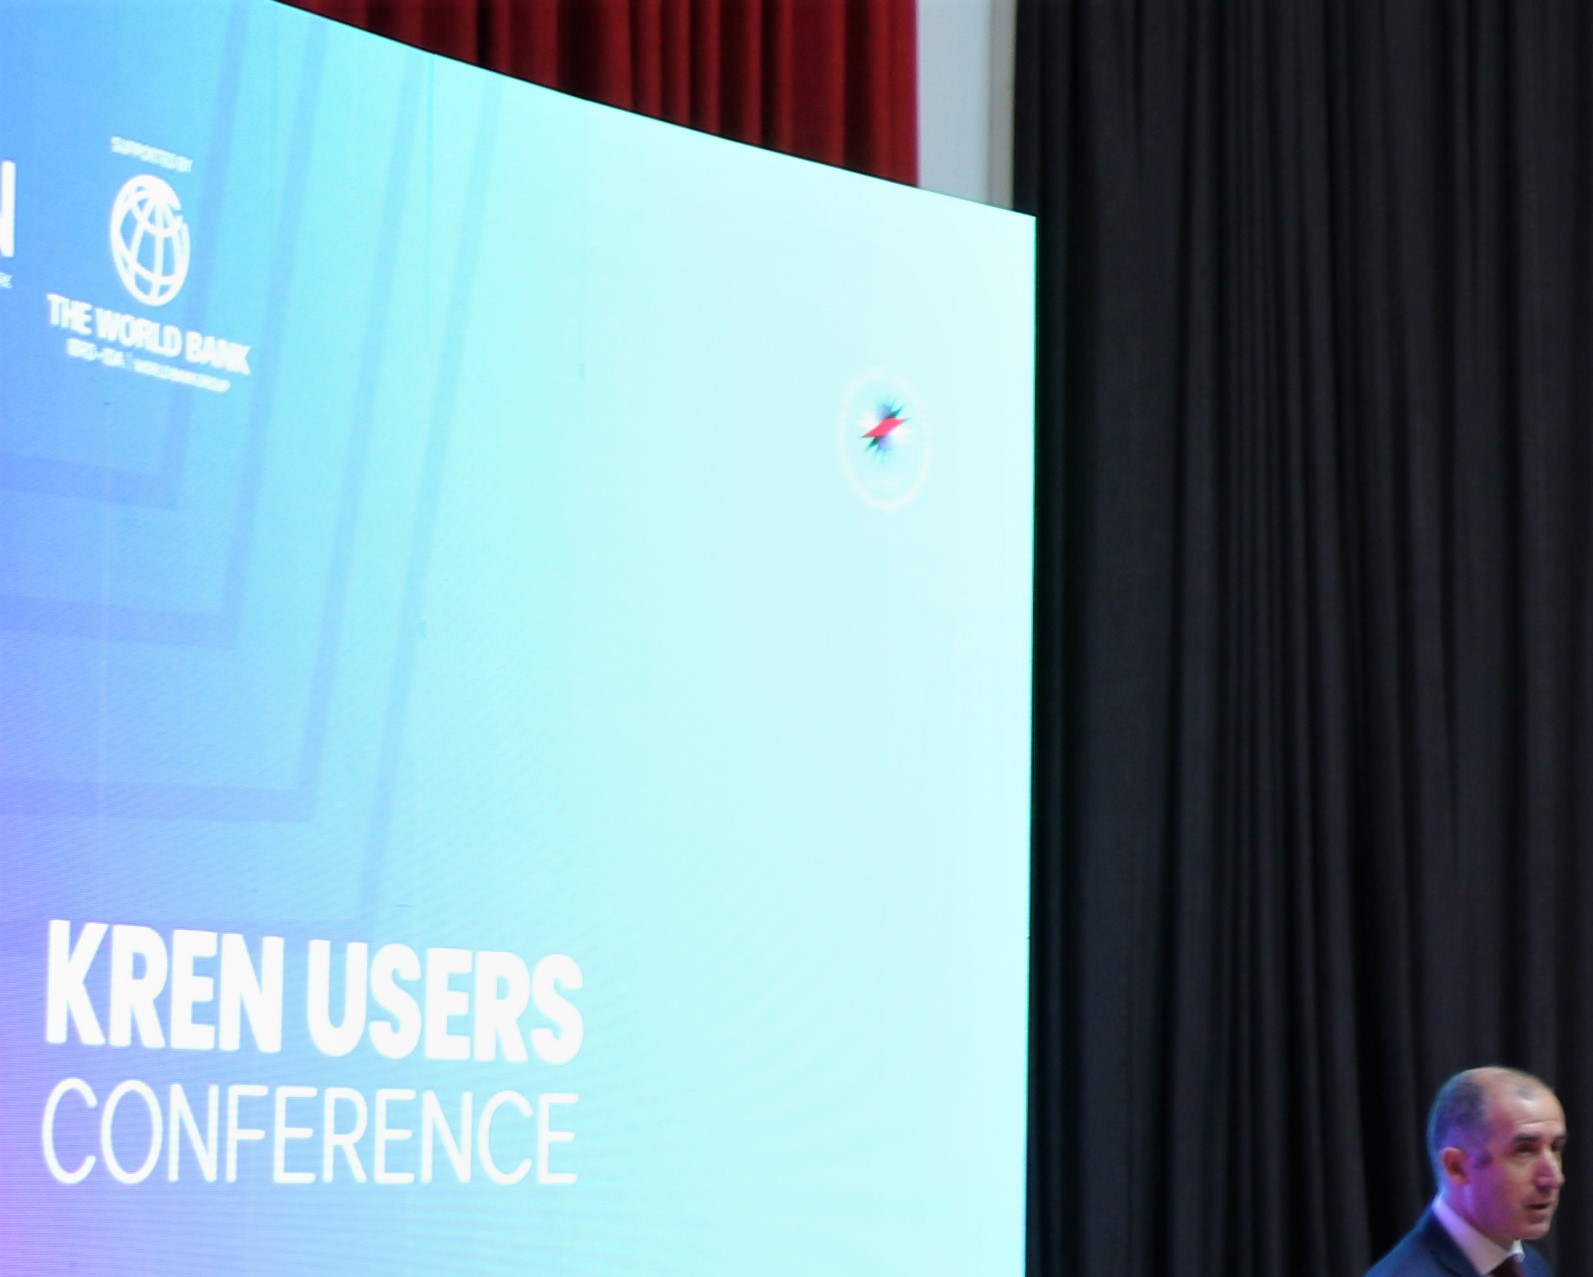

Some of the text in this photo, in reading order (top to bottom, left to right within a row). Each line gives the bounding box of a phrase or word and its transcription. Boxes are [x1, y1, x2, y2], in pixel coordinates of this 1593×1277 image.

[46, 293, 93, 336] THE
[94, 307, 183, 358] WORLD
[184, 330, 252, 376] BANK
[45, 919, 584, 1064] KREN USERS
[41, 1077, 580, 1185] CONFERENCE
